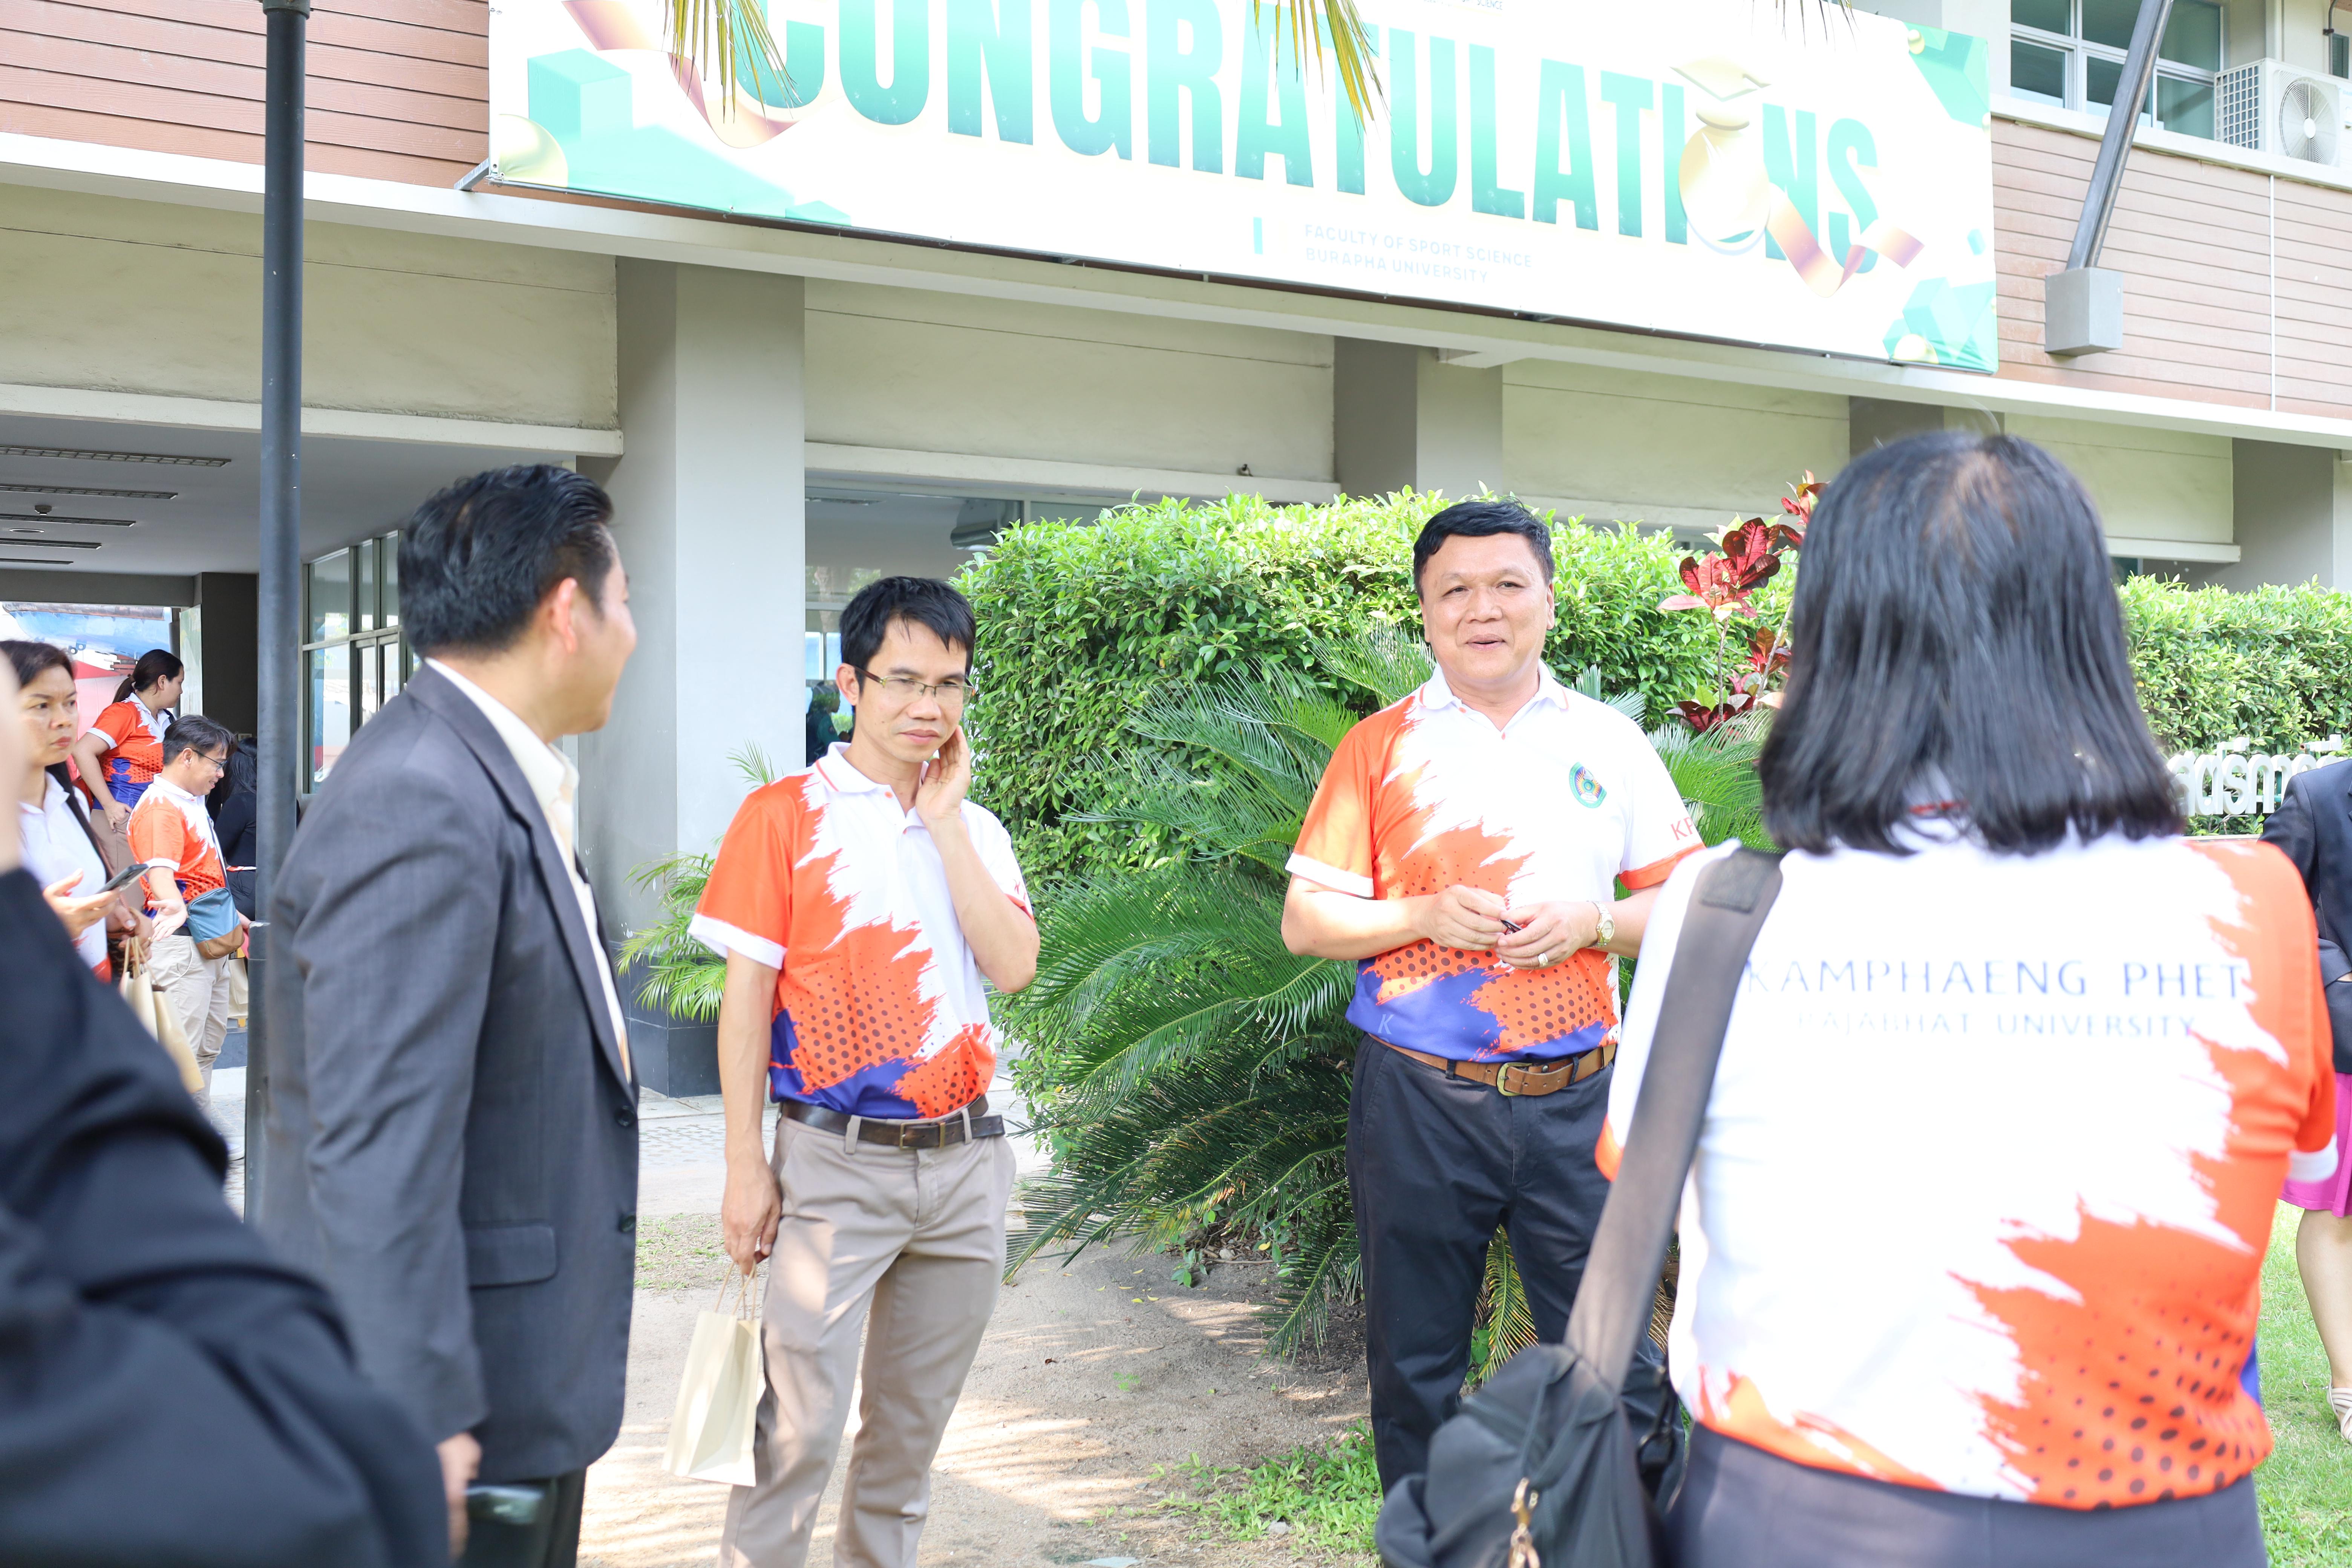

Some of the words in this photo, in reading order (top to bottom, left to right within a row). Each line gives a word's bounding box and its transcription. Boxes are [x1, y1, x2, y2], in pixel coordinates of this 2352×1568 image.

[1305, 224, 1377, 246] FACULTY
[1384, 235, 1403, 249] OF
[1409, 238, 1461, 257] SPORT
[1467, 247, 1531, 267] SCIENCE
[1306, 247, 1386, 271] BURAPHA
[1393, 259, 1487, 283] UNIVERSITY
[1747, 959, 2086, 996] KAMPHAENG
[2123, 962, 2243, 999] PHET
[1997, 1014, 2194, 1038] UNIVERSITY
